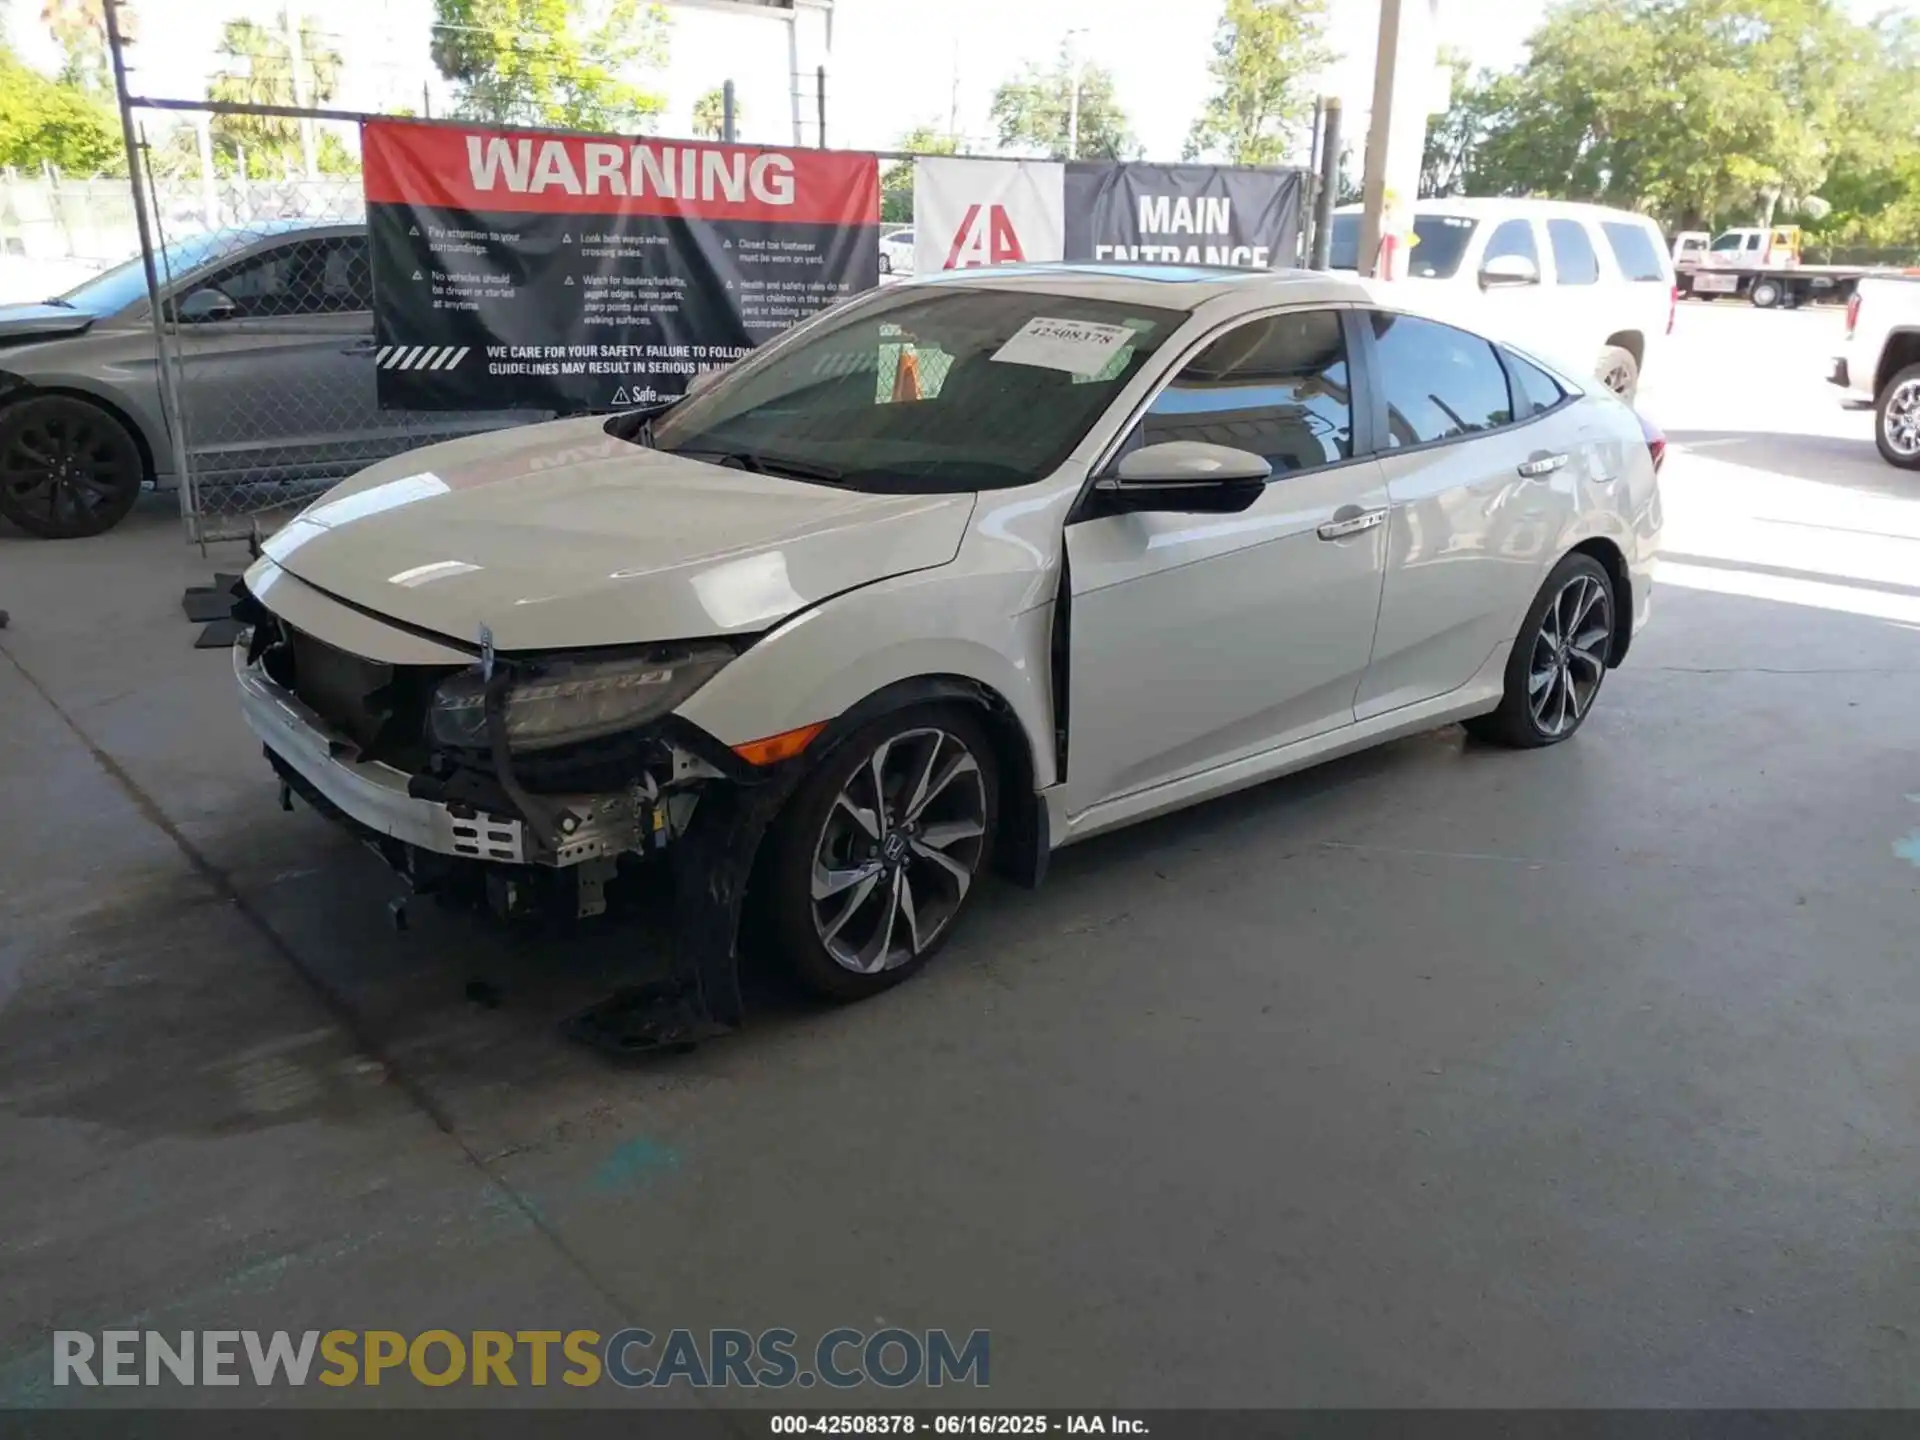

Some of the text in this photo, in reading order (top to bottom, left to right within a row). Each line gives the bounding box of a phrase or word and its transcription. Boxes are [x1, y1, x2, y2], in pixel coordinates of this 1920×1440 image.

[465, 135, 796, 206] WARNING
[1139, 195, 1231, 235] MAIN
[428, 225, 445, 239] Pay
[580, 232, 601, 244] Look
[622, 235, 644, 246] ways
[645, 235, 669, 246] when
[738, 239, 816, 252] Closed toe footwear
[581, 247, 616, 258] crossing
[739, 253, 759, 264] must
[772, 255, 792, 264] worn
[793, 255, 804, 264] on
[805, 255, 825, 266] yard.
[432, 271, 510, 284] No vehicles should
[583, 274, 608, 285] Watch
[609, 274, 621, 285] for
[432, 284, 515, 298] be driven or started
[766, 280, 780, 290] and
[782, 280, 806, 292] safety
[827, 281, 838, 291] do
[433, 300, 443, 309] at
[766, 293, 797, 304] children
[807, 294, 819, 304] the
[584, 302, 679, 314] sharp points and uneven
[742, 306, 759, 317] yard
[760, 308, 769, 316] or
[770, 305, 799, 318] bidding
[583, 315, 652, 327] walking surfaces.
[486, 345, 508, 358] WE
[510, 345, 543, 358] CARE
[544, 345, 566, 358] FOR
[568, 344, 598, 357] YOUR
[600, 344, 645, 357] SAFETY.
[646, 344, 690, 357] FAILURE
[692, 345, 706, 357] TO
[488, 362, 559, 375] GUIDELINES
[561, 361, 587, 374] MAY
[588, 361, 631, 374] RESULT
[633, 361, 646, 374] IN
[649, 361, 696, 374] SERIOUS
[632, 385, 657, 402] Safe
